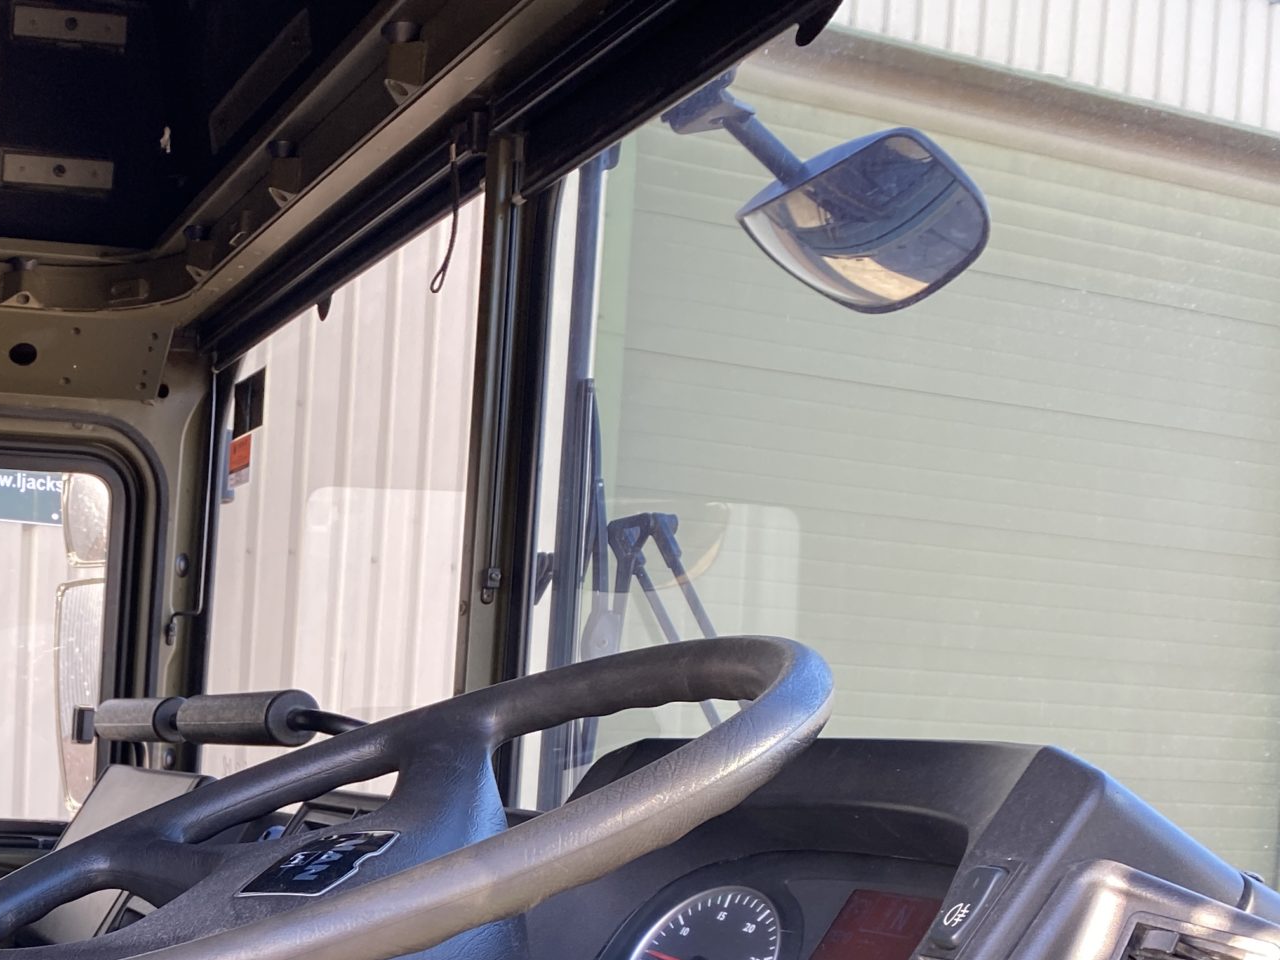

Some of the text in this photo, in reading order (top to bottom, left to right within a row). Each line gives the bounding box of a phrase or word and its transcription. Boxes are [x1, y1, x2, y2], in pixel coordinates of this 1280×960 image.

[717, 911, 728, 921] 15
[680, 926, 690, 936] 10
[742, 922, 756, 934] 20
